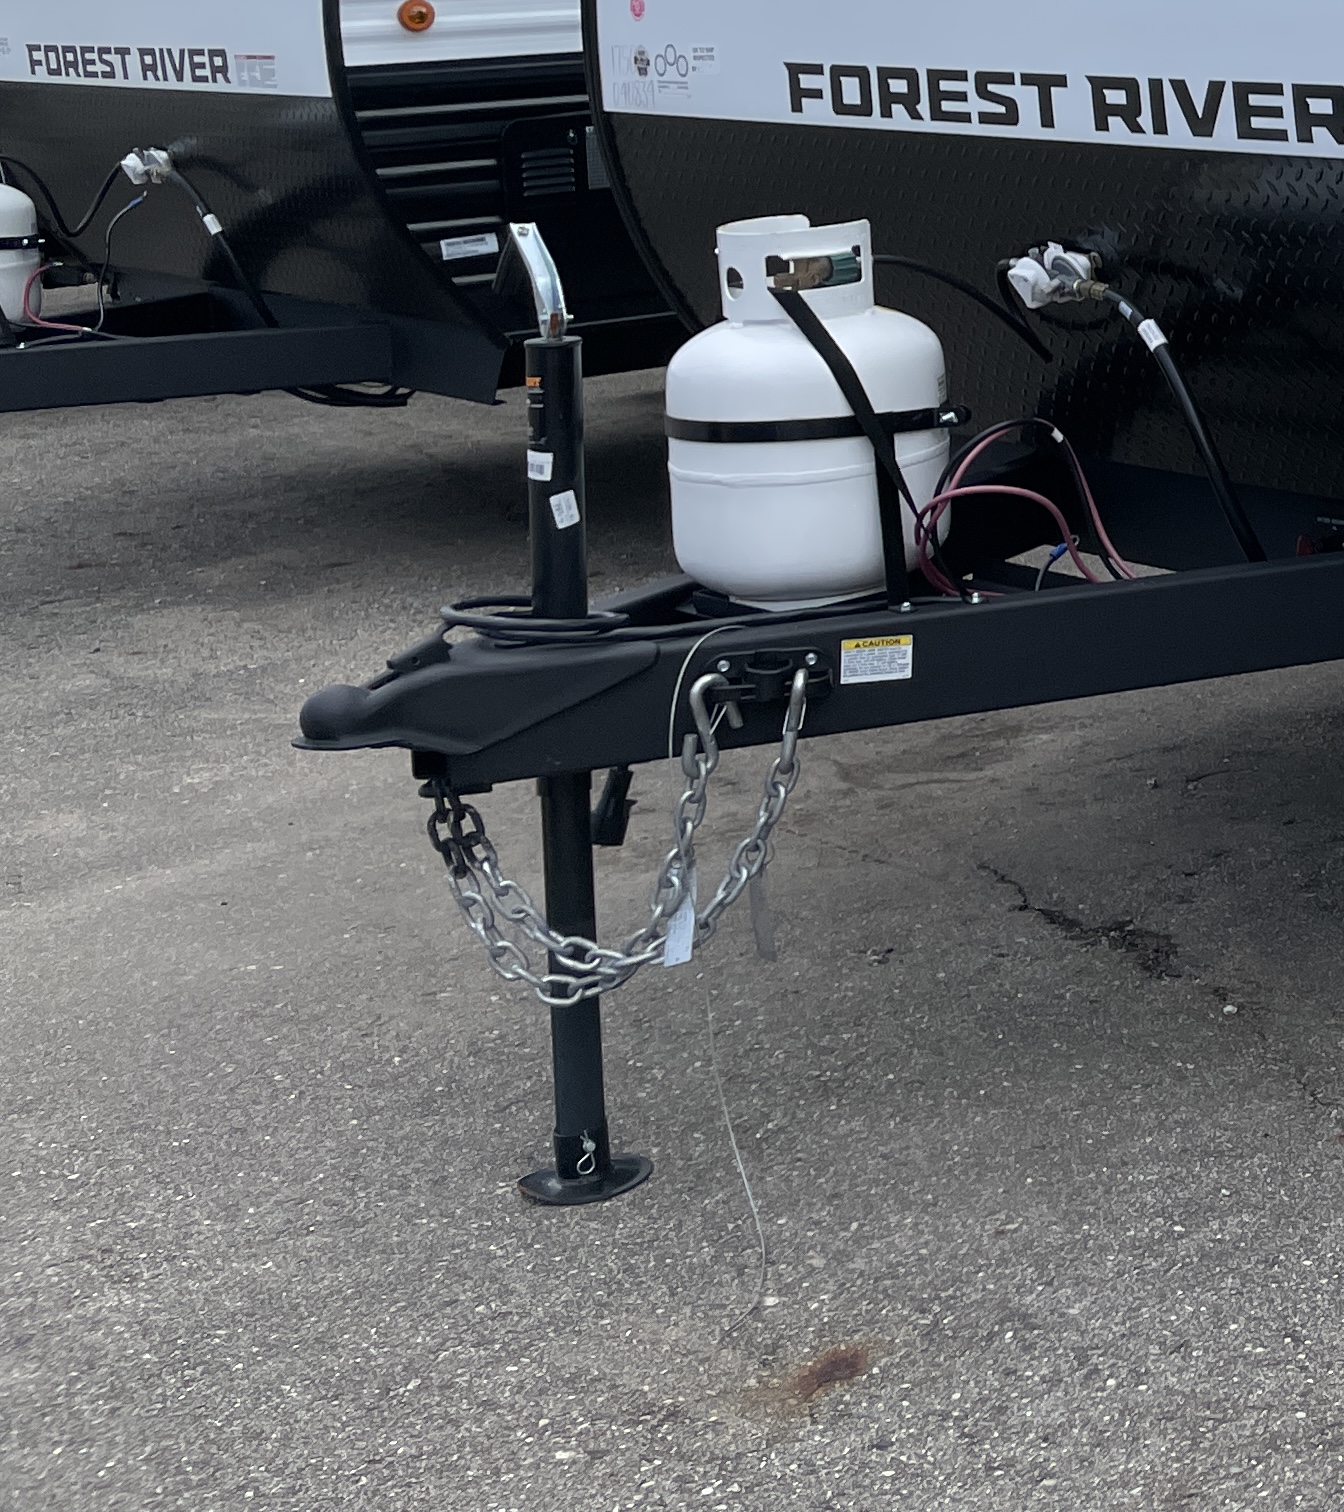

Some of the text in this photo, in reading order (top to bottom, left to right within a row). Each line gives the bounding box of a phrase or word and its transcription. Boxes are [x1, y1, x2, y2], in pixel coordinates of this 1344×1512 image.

[25, 43, 132, 81] FOREST
[136, 46, 233, 85] RIVER
[782, 61, 1068, 129] FOREST
[862, 638, 901, 648] CAUTION
